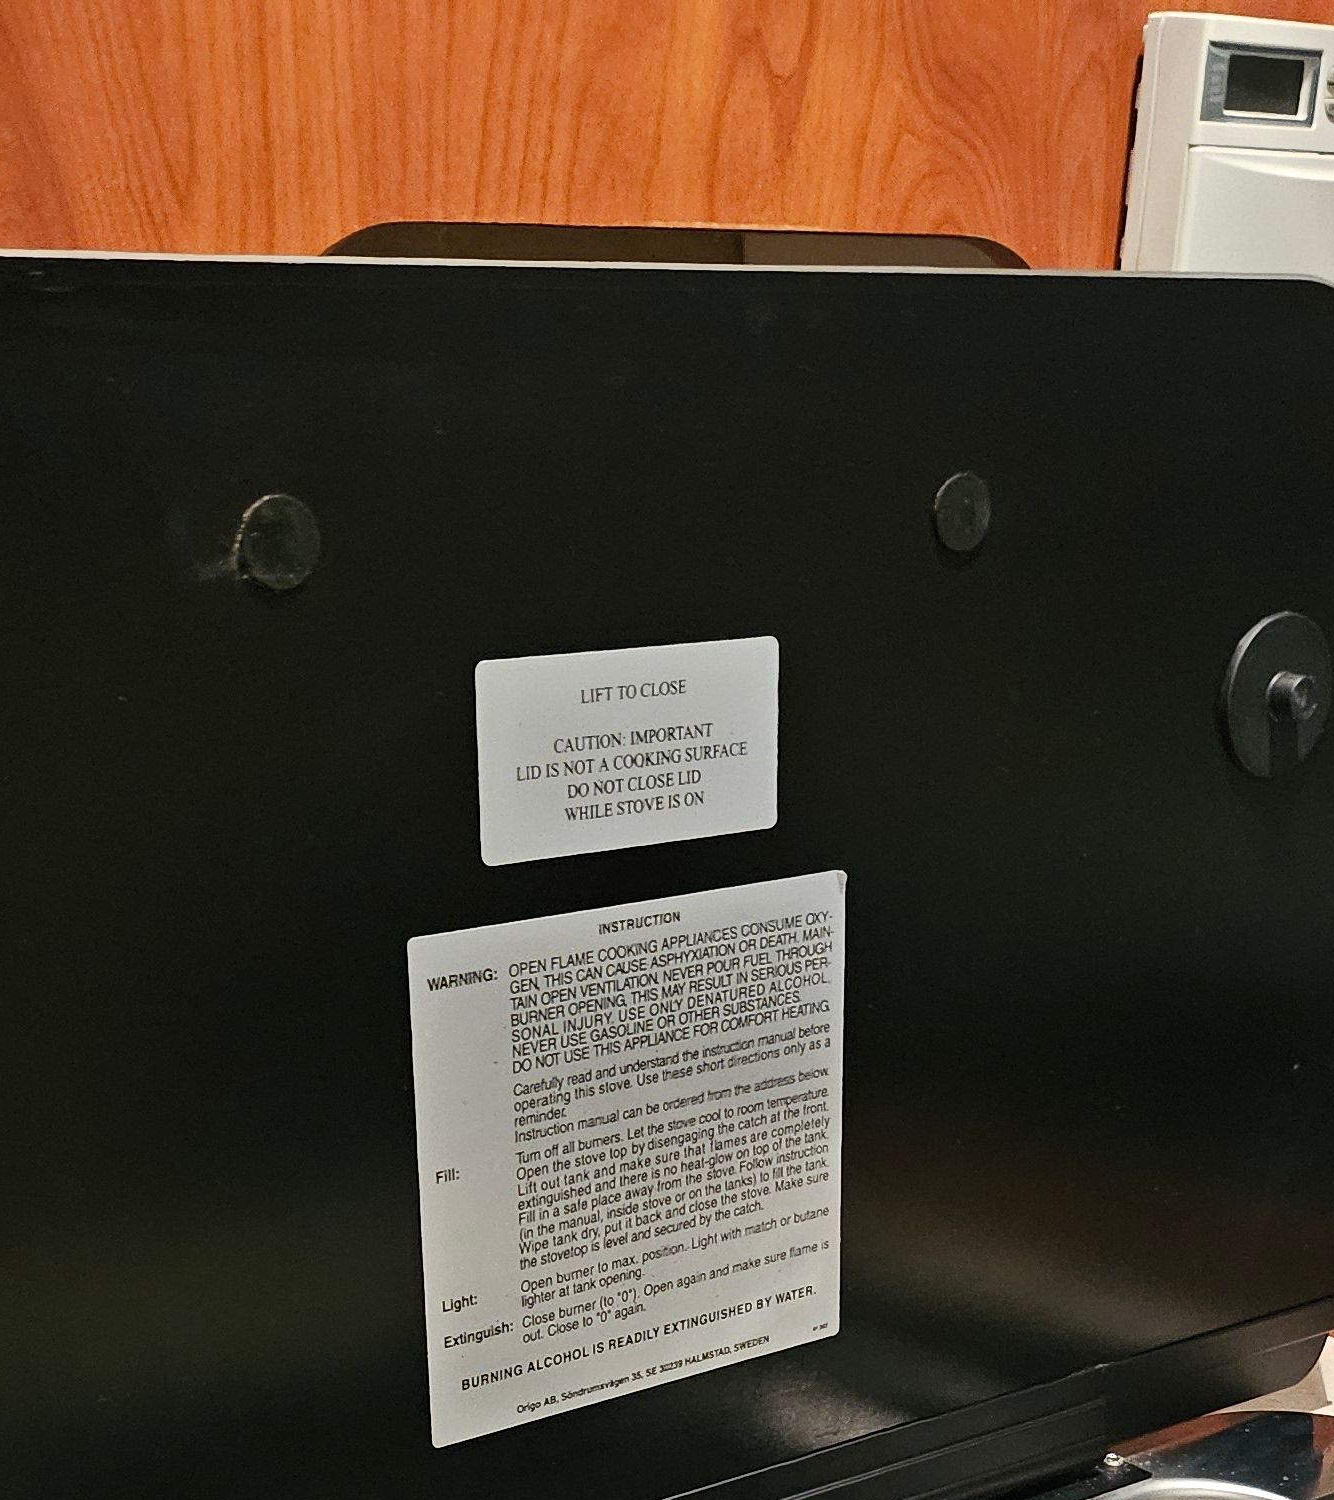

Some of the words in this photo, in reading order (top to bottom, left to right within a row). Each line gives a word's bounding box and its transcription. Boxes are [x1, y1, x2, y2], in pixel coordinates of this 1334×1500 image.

[581, 687, 613, 704] LIFT
[618, 685, 636, 700] TO
[640, 680, 687, 698] CLOSE
[554, 733, 626, 754] CAUTION:
[631, 724, 714, 745] IMPORTANT
[516, 765, 541, 782] LID
[547, 763, 559, 777] IS
[564, 760, 592, 776] NOT
[599, 760, 610, 772] A
[613, 748, 681, 770] COOKING
[685, 742, 748, 762] SURFACE
[567, 782, 589, 798] DO
[593, 778, 624, 796] NOT
[627, 774, 674, 792] CLOSE
[678, 770, 701, 784] LID
[565, 804, 613, 821] WHILE
[617, 796, 663, 816] STOVE
[668, 796, 680, 808] IS
[684, 792, 704, 805] ON
[599, 911, 680, 935] INSTRUCTION
[509, 959, 547, 977] OPEN
[551, 950, 595, 971] FLAME
[597, 939, 658, 962] COOKING
[661, 926, 738, 951] APPLIANCES
[741, 915, 802, 937] CONSUME
[805, 911, 832, 925] OXY-
[540, 969, 574, 990] THIS
[574, 965, 603, 982] CAN
[606, 957, 649, 977] CAUSE
[650, 942, 736, 969] ASPHYXIATION
[739, 938, 758, 953] OR
[802, 925, 833, 942] MAIN-
[427, 968, 498, 991] WARNING:
[510, 993, 537, 1010] TAIN
[540, 986, 577, 1006] OPEN
[663, 963, 705, 984] NEVER
[705, 957, 740, 977] POUR
[743, 952, 773, 968] FUEL
[773, 941, 832, 964] THROUGH
[511, 1004, 566, 1027] BURNER
[627, 988, 658, 1006] THIS
[660, 981, 686, 1000] MAY
[689, 973, 733, 994] RESULT
[736, 970, 748, 985] IN
[751, 960, 802, 982] SERIOUS
[805, 957, 830, 973] PER-
[512, 1022, 559, 1043] SONAL
[619, 1004, 648, 1022] USE
[648, 998, 683, 1017] ONLY
[687, 983, 767, 1009] DENATURED
[513, 1034, 557, 1058] NEVER
[561, 1031, 588, 1048] USE
[588, 1018, 656, 1044] GASOLINE
[656, 1014, 676, 1031] OR
[678, 1006, 720, 1025] OTHER
[513, 1055, 533, 1074] DO
[534, 1050, 560, 1069] NOT
[565, 1044, 591, 1063] USE
[591, 1040, 623, 1057] THIS
[624, 1025, 690, 1052] APPLIANCE
[693, 1021, 718, 1037] FOR
[721, 1009, 779, 1032] COMFORT
[436, 1168, 459, 1184] Fill:
[442, 1295, 477, 1312] Light:
[521, 1287, 557, 1309] lighter
[558, 1284, 569, 1297] at
[573, 1277, 597, 1294] tank
[598, 1268, 644, 1289] opening.
[522, 1311, 557, 1331] Close
[557, 1300, 598, 1325] burner
[599, 1296, 615, 1314] (to
[644, 1281, 673, 1297] Open
[677, 1272, 706, 1289] again
[709, 1264, 729, 1279] and
[733, 1258, 761, 1273] make
[764, 1252, 786, 1264] sure
[790, 1244, 817, 1258] flame
[822, 1241, 829, 1249] is
[444, 1322, 513, 1348] Extinguish:
[462, 1365, 523, 1391] BURNING
[527, 1346, 589, 1373] ALCOHOL
[593, 1342, 604, 1355] IS
[609, 1326, 660, 1350] READILY
[664, 1302, 752, 1335] EXTINGUISHED
[757, 1296, 772, 1309] BY
[775, 1286, 816, 1304] WATER.
[546, 1320, 579, 1336] Close
[583, 1316, 593, 1327] to
[613, 1302, 645, 1320] again.
